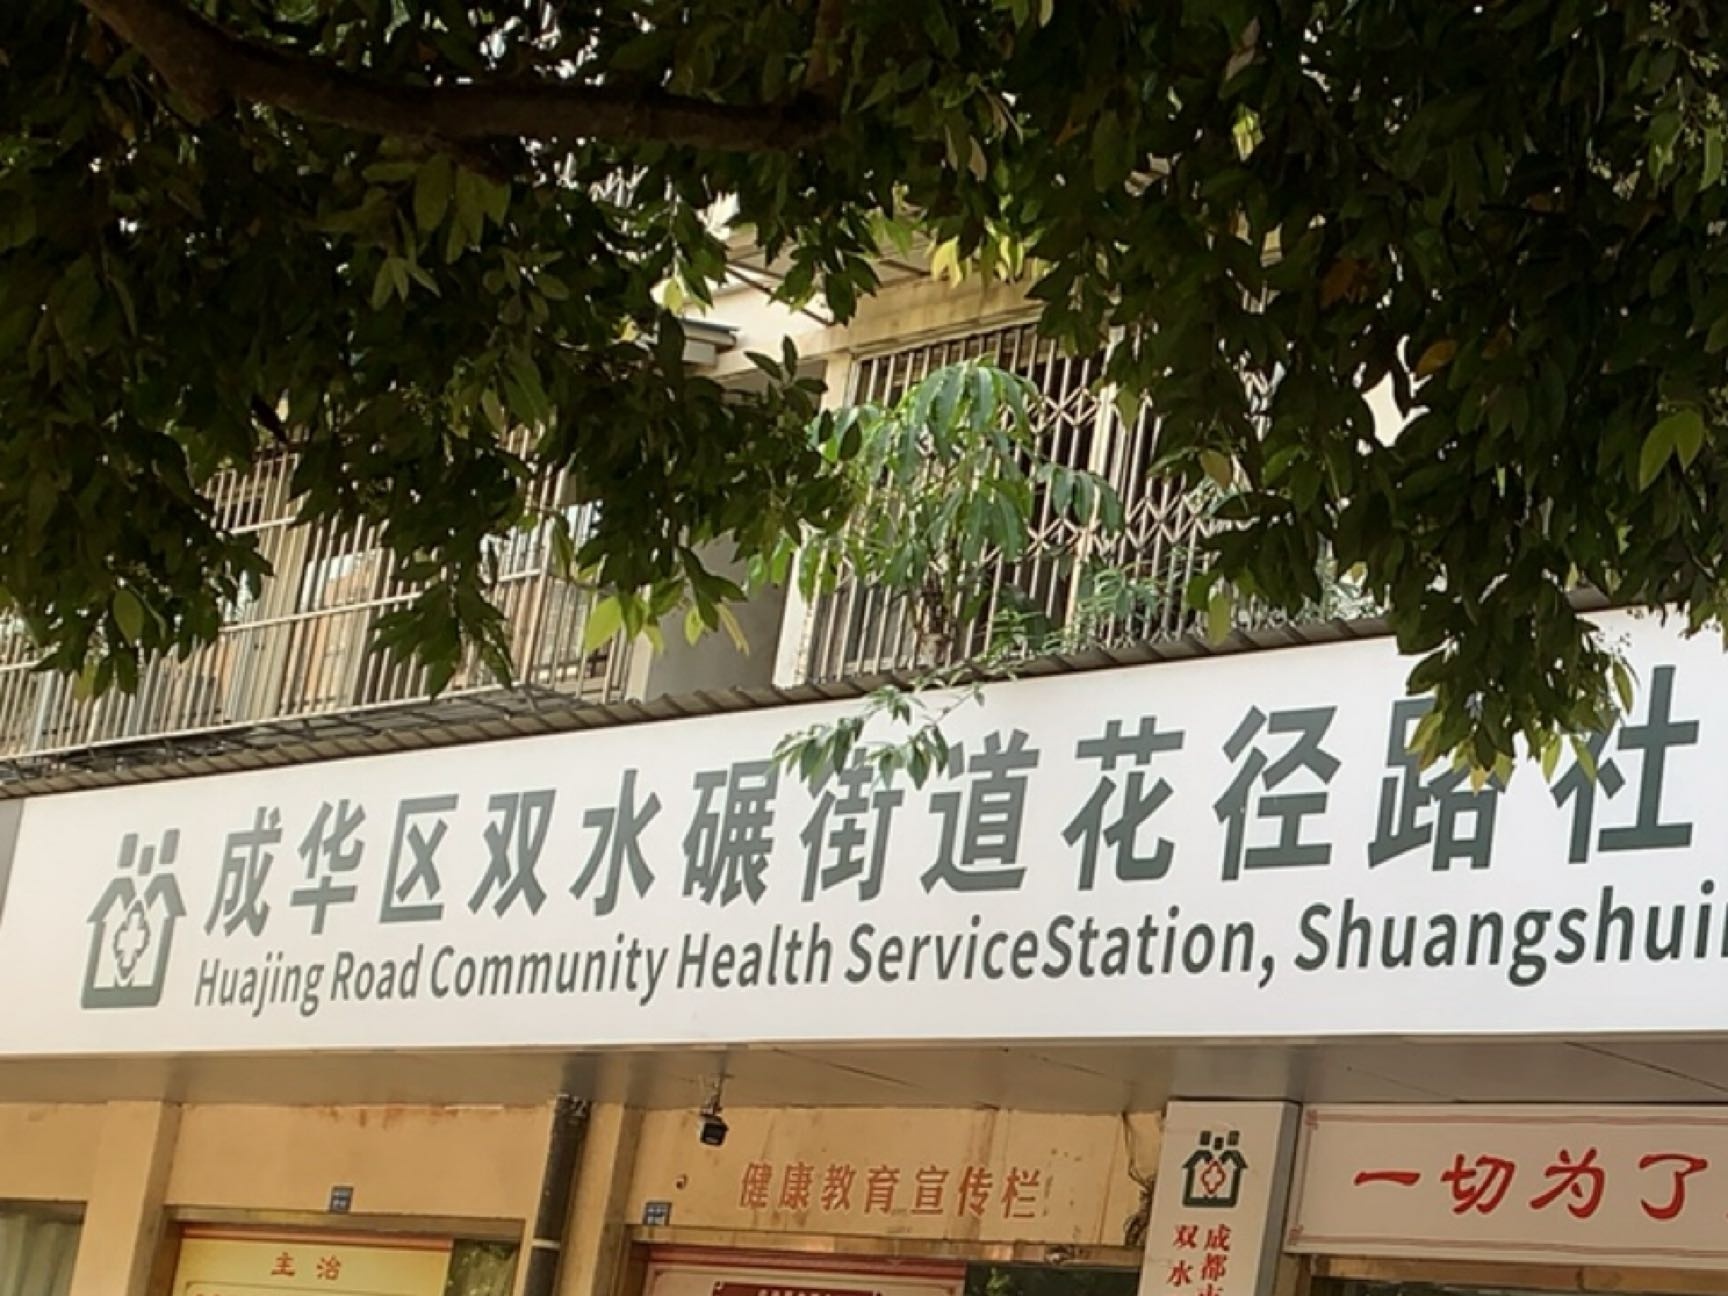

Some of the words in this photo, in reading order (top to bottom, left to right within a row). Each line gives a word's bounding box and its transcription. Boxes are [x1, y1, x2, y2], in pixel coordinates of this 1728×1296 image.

[194, 951, 325, 1018] Huajing
[330, 943, 421, 1001] Road
[431, 932, 669, 1007] Community
[676, 922, 832, 989] Health
[844, 905, 1275, 989] ServiceStation,
[739, 1162, 1042, 1220] 健康教育宣传栏
